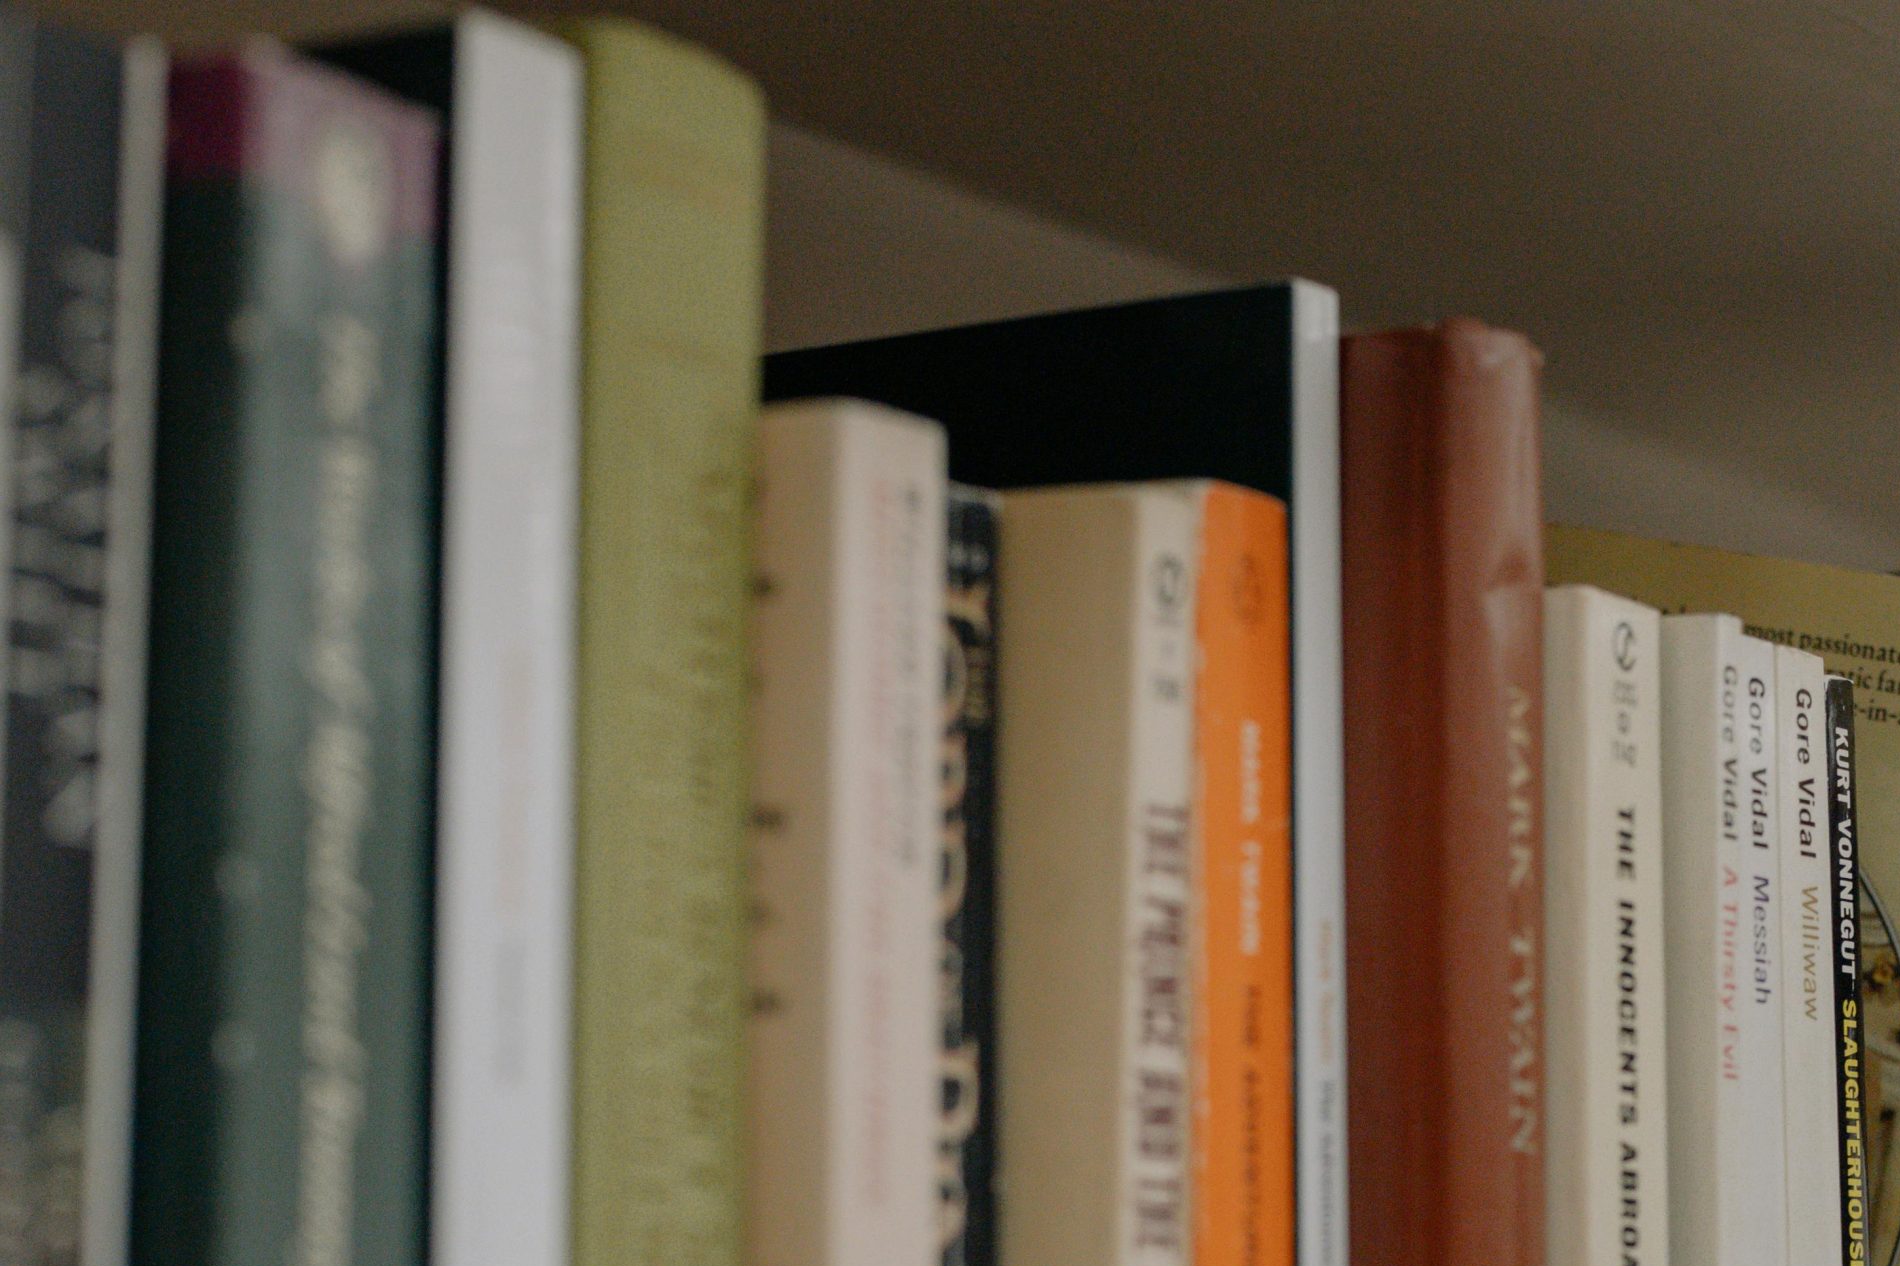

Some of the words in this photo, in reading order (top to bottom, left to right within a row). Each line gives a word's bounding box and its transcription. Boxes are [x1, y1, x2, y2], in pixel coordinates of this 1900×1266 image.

[1721, 665, 1739, 746] Gore
[1748, 676, 1766, 756] Gore
[1795, 688, 1813, 765] Gore
[1505, 684, 1532, 888] MARK
[1721, 757, 1739, 842] Vidal
[1835, 726, 1852, 806] KURT
[1614, 806, 1638, 883] THE
[1750, 767, 1769, 850] Vidal
[1797, 776, 1817, 860] Vidal
[1752, 875, 1773, 1006] Messiah
[1837, 819, 1857, 980] VONNEGUT
[1721, 902, 1739, 1013] Thirsty
[1800, 885, 1819, 1021] Williwaw
[1509, 927, 1538, 1155] TWAIN
[1616, 901, 1639, 1128] INNOCENTS
[1722, 1024, 1739, 1081] Evil
